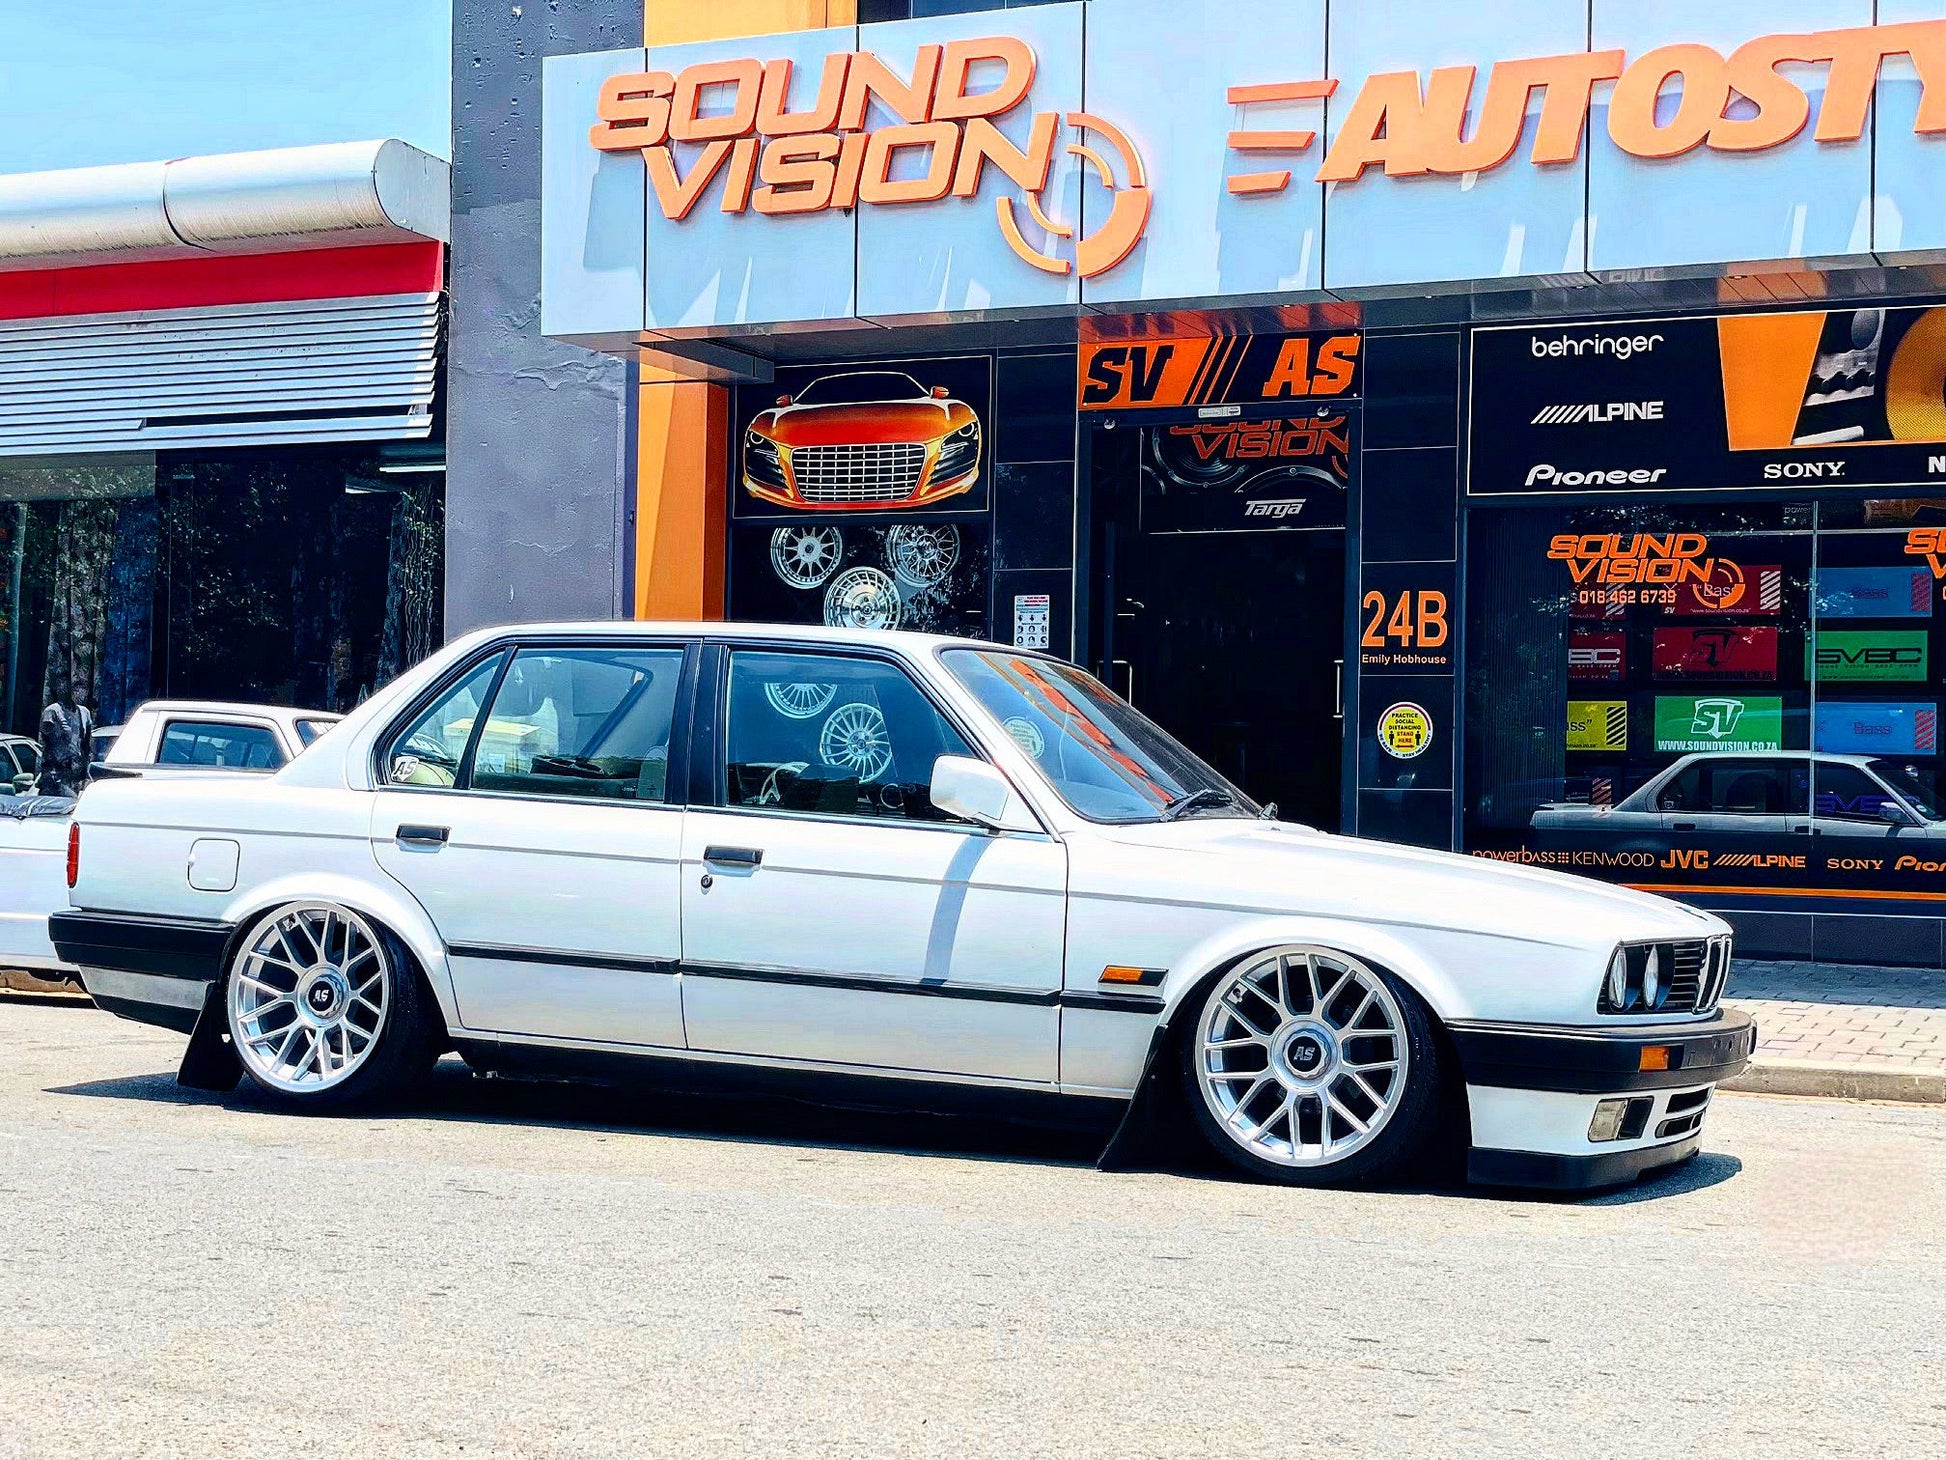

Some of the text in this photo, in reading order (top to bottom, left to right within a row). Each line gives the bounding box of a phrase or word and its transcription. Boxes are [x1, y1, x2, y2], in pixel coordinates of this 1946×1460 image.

[590, 36, 1037, 151] SOUND
[641, 111, 1059, 220] VISION
[1532, 333, 1664, 360] behringer
[1081, 335, 1361, 403] SV AS
[1192, 429, 1349, 460] VISION
[1525, 464, 1667, 487] Pioneer
[1245, 498, 1306, 519] Targa
[1547, 534, 1707, 559] SOUND
[1567, 558, 1715, 583] VISION
[1579, 590, 1607, 605] 018
[1609, 590, 1636, 605] 462
[1640, 589, 1676, 604] 6739
[1362, 590, 1448, 648] 24B
[1362, 653, 1447, 666] Emily Hobhouse
[1691, 703, 1744, 734] SV
[1658, 740, 1779, 752] WWW.SOUNDVISION.CO.ZA
[394, 761, 418, 775] AS
[1573, 851, 1655, 867] KENWOOD
[1660, 849, 1709, 870] JVC
[1827, 858, 1884, 871] SONY
[1293, 1046, 1316, 1061] AS
